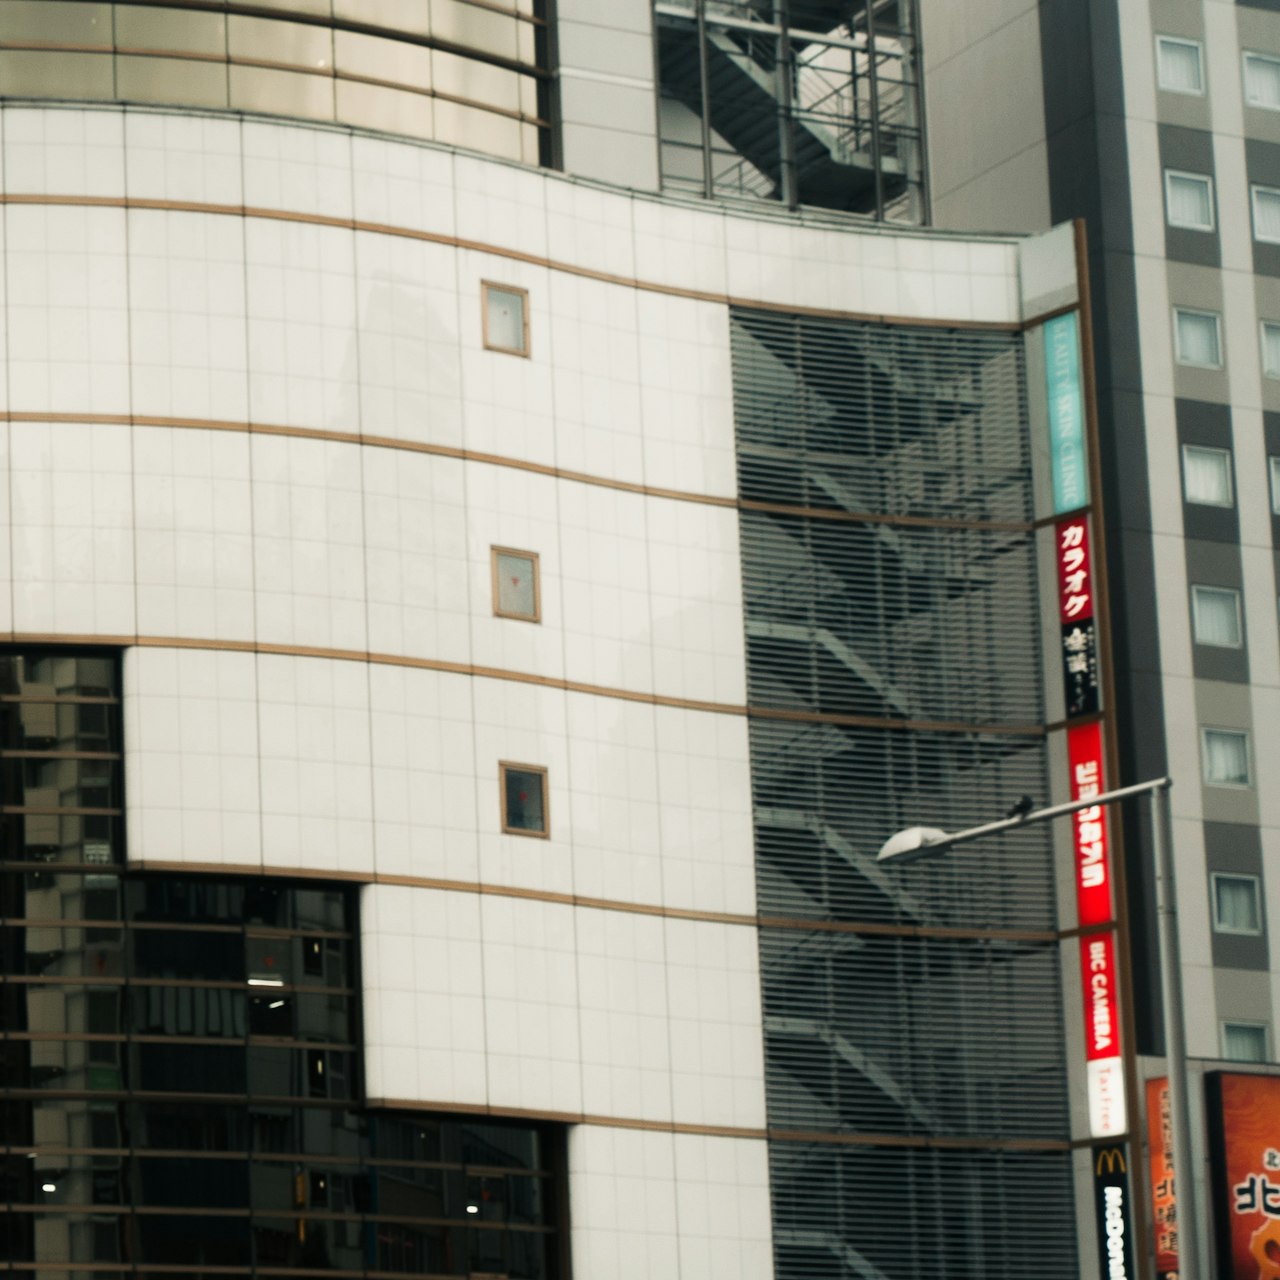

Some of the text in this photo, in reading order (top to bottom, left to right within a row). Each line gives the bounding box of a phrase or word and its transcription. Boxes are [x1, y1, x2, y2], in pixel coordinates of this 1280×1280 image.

[1058, 393, 1076, 439] SKIN
[1061, 524, 1091, 618] カラオケ
[1089, 941, 1113, 1051] BIC CAMERA
